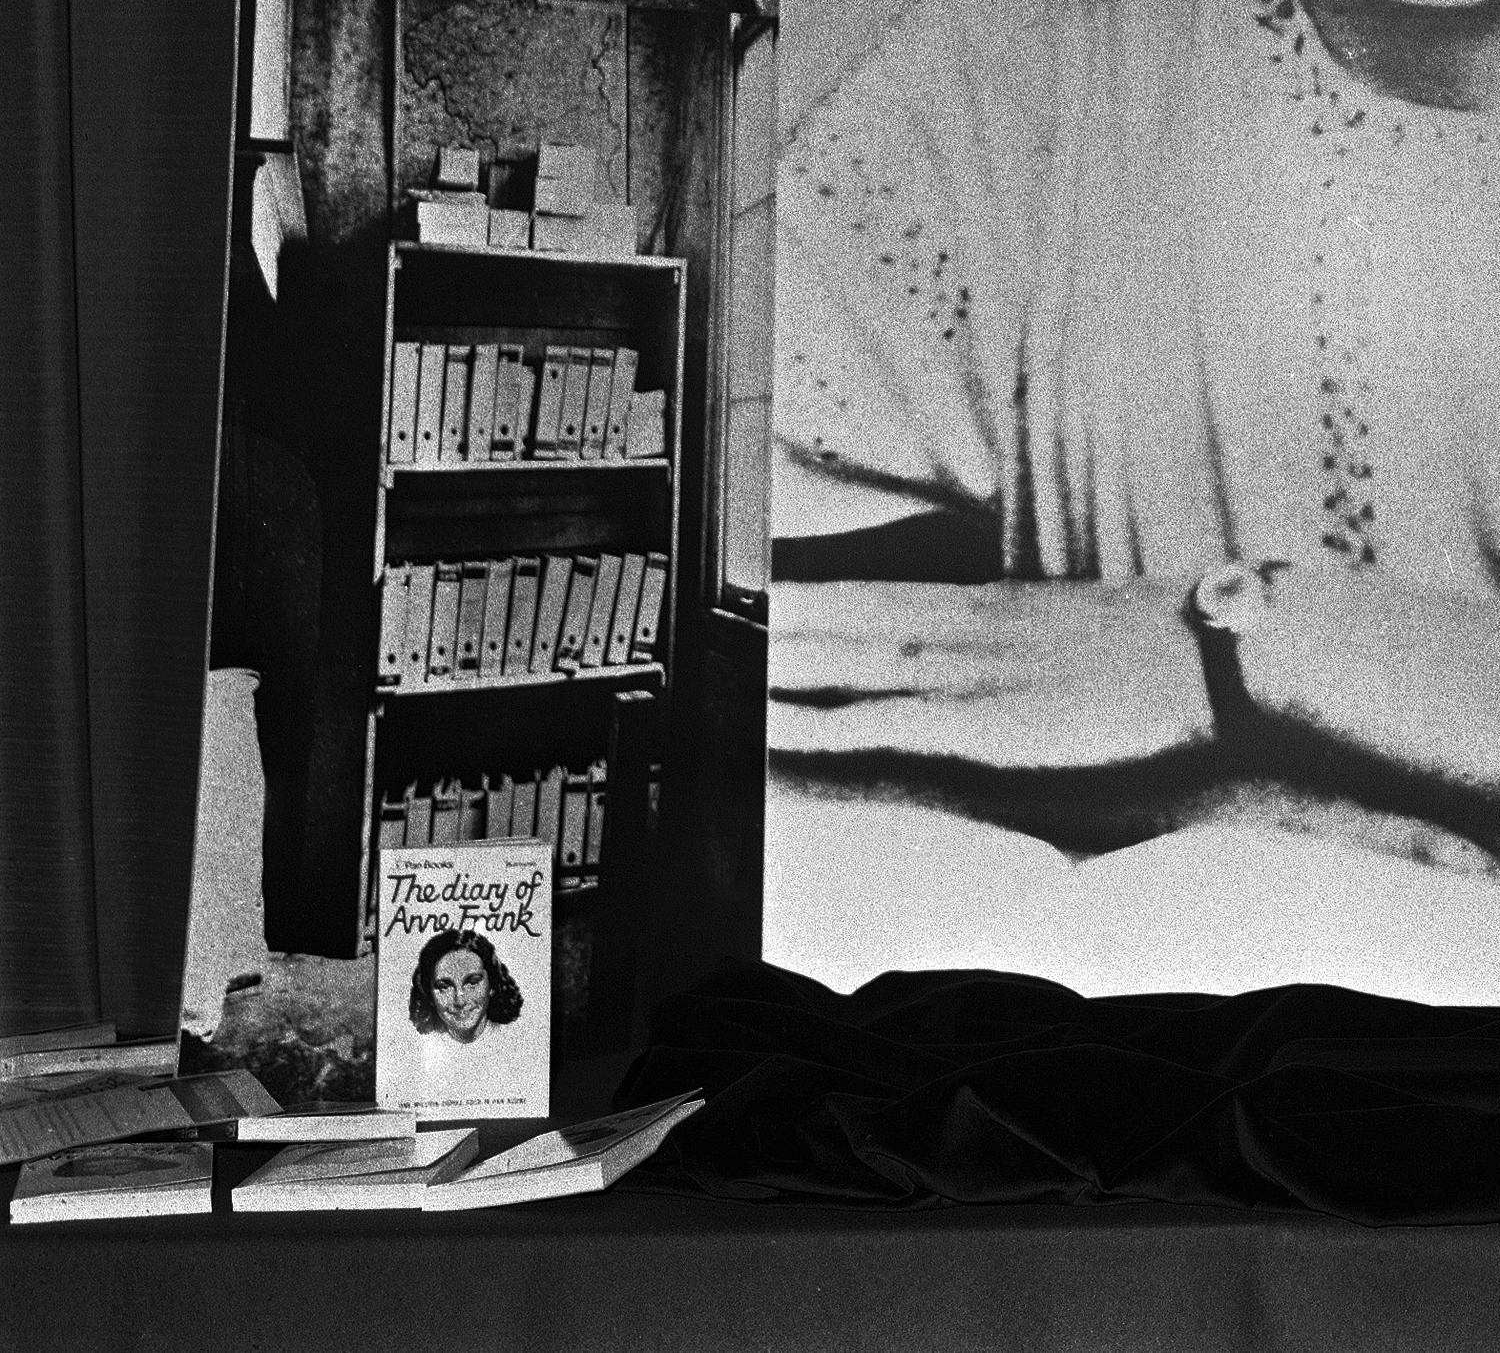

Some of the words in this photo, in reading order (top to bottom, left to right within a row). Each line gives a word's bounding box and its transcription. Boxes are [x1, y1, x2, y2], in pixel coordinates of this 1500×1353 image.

[387, 873, 440, 903] The
[442, 873, 508, 912] diary
[515, 871, 544, 911] of
[384, 905, 454, 937] Anne
[459, 903, 541, 937] Frank
